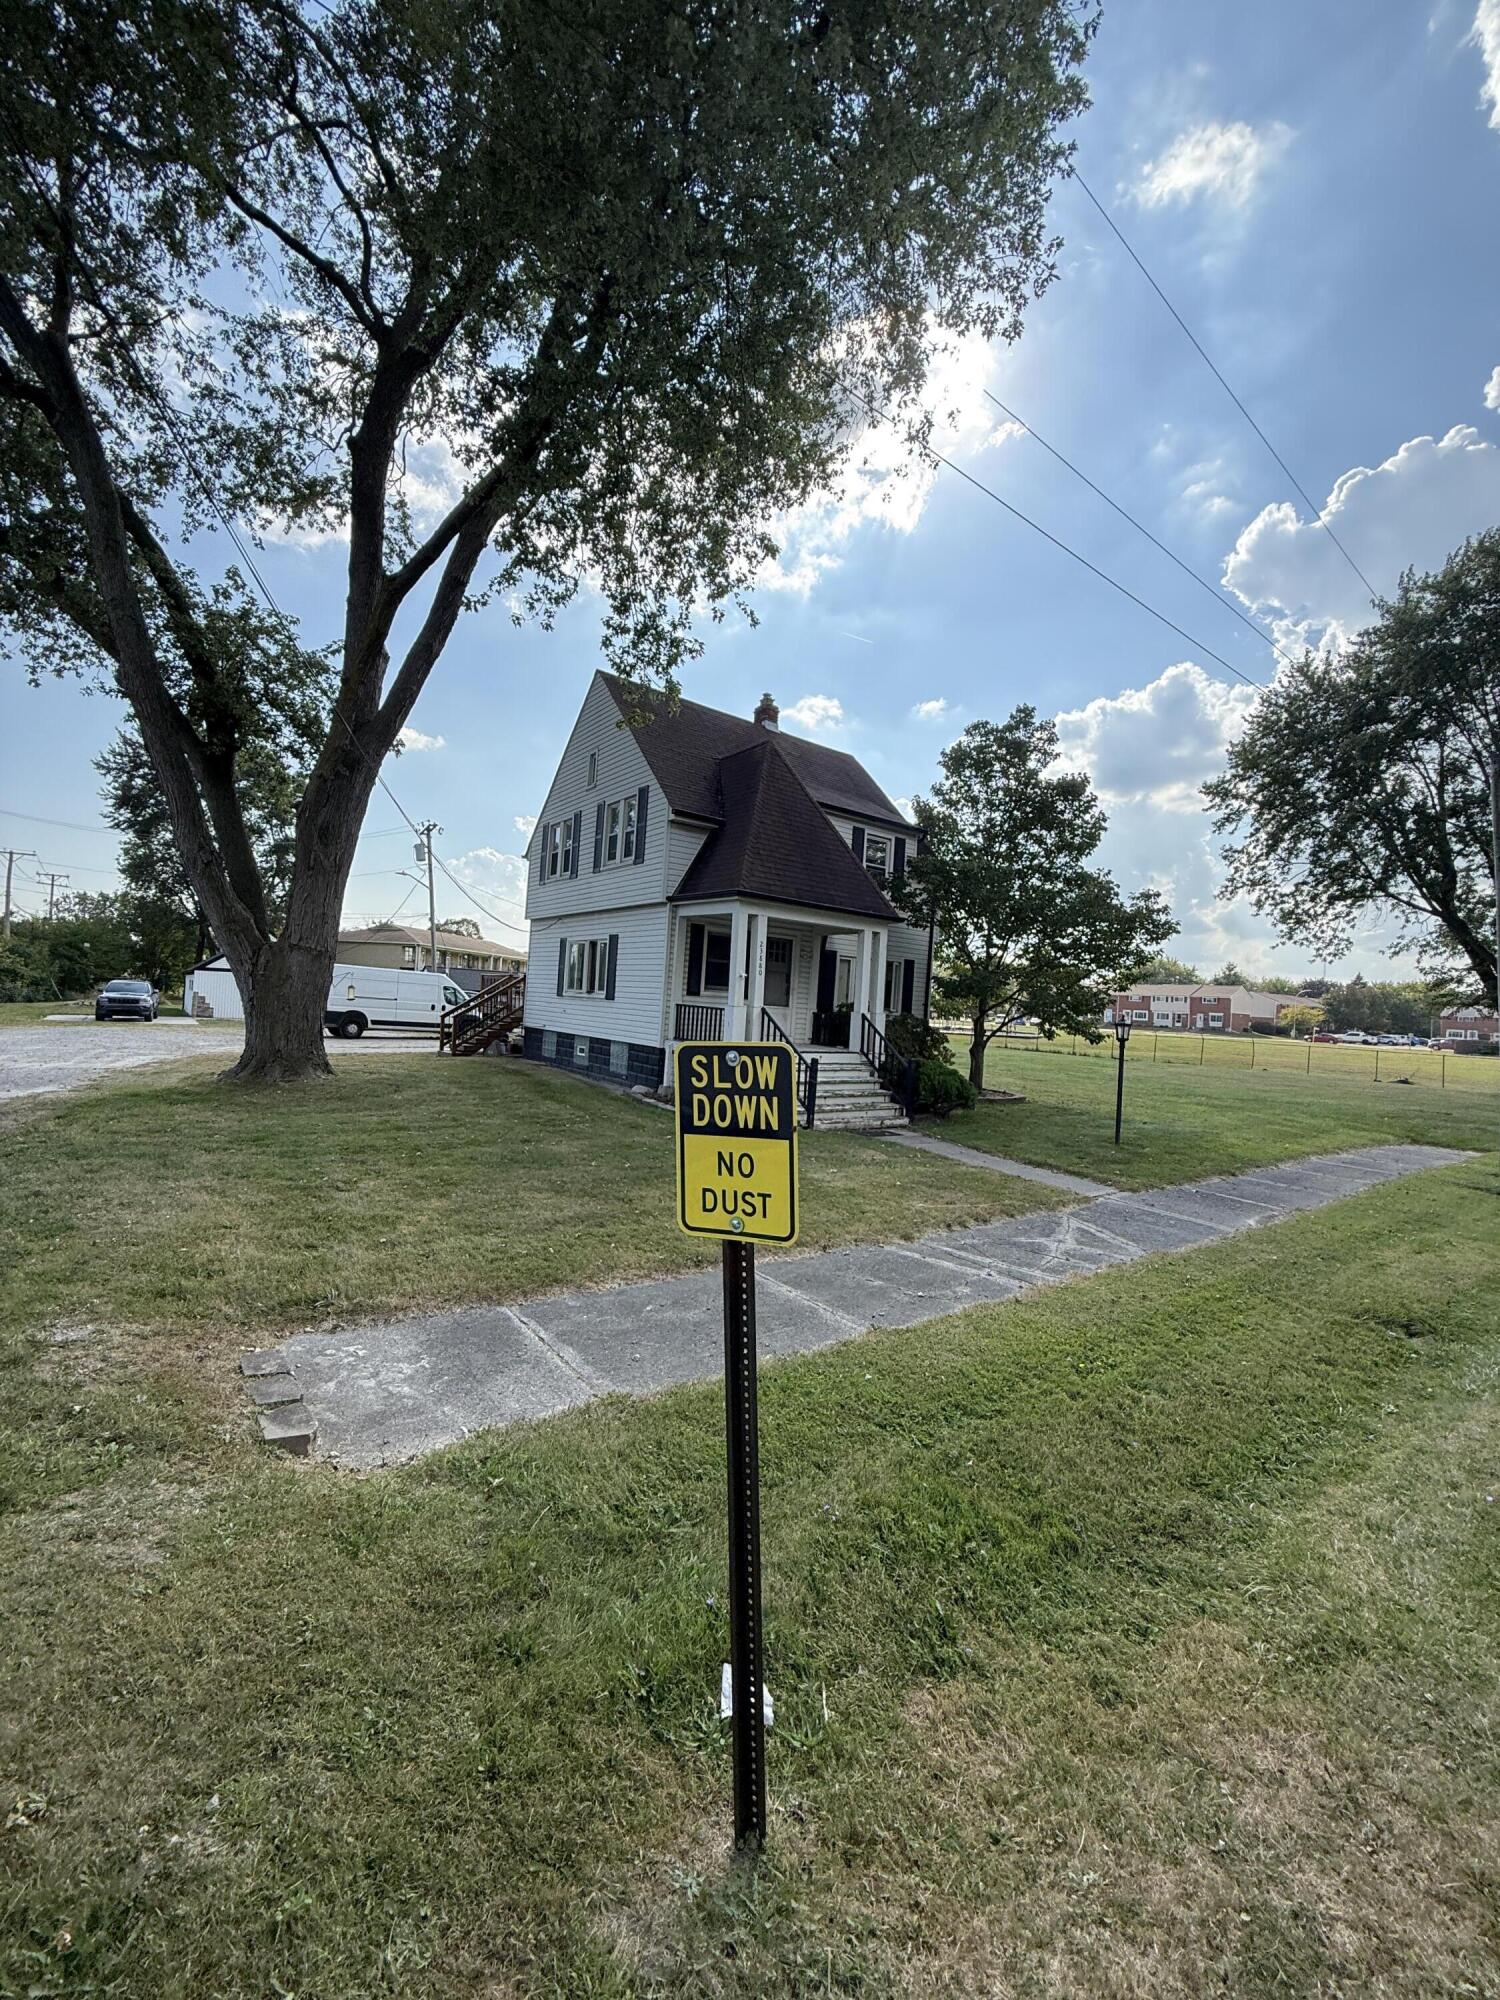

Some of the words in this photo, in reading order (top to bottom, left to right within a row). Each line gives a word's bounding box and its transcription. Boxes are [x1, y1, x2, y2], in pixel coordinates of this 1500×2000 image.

[691, 1055, 778, 1090] SLOW
[692, 1093, 779, 1131] DOWN
[717, 1151, 755, 1178] NO
[701, 1187, 772, 1218] DUST
